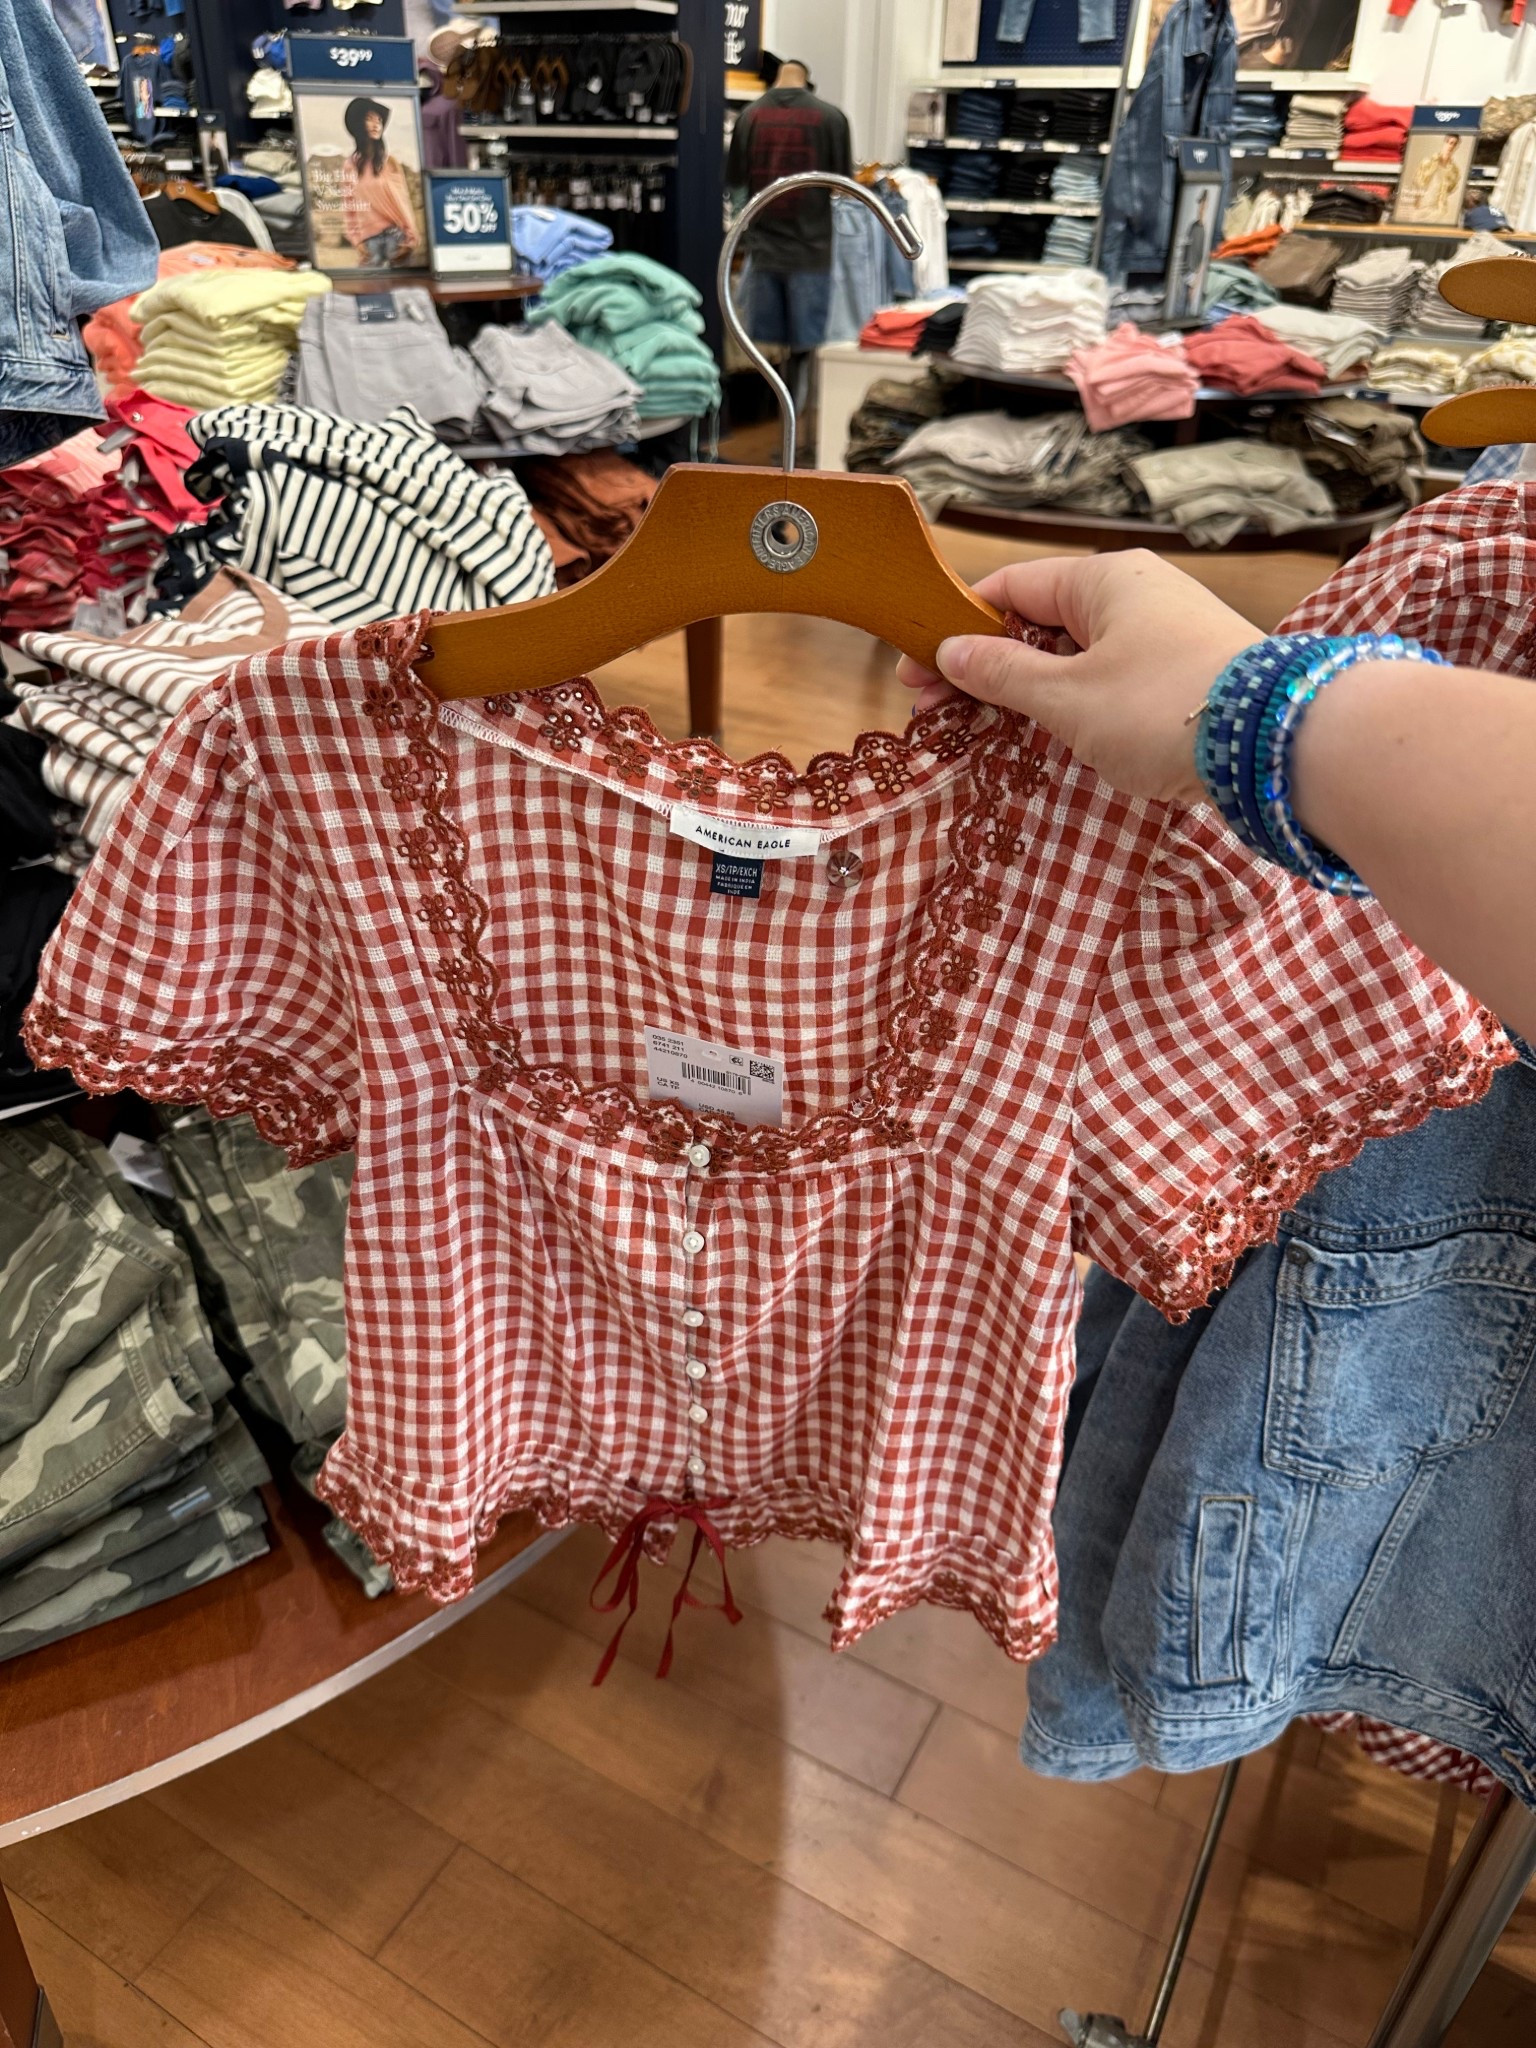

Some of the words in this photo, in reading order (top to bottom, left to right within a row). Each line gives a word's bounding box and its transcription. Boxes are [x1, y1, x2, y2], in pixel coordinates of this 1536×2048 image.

[443, 201, 499, 234] 50%
[695, 825, 752, 848] AMERICAN
[757, 839, 791, 850] EAGLE
[715, 863, 758, 877] XS/TP/EXCH
[715, 874, 731, 882] MADE
[698, 1102, 715, 1111] USD
